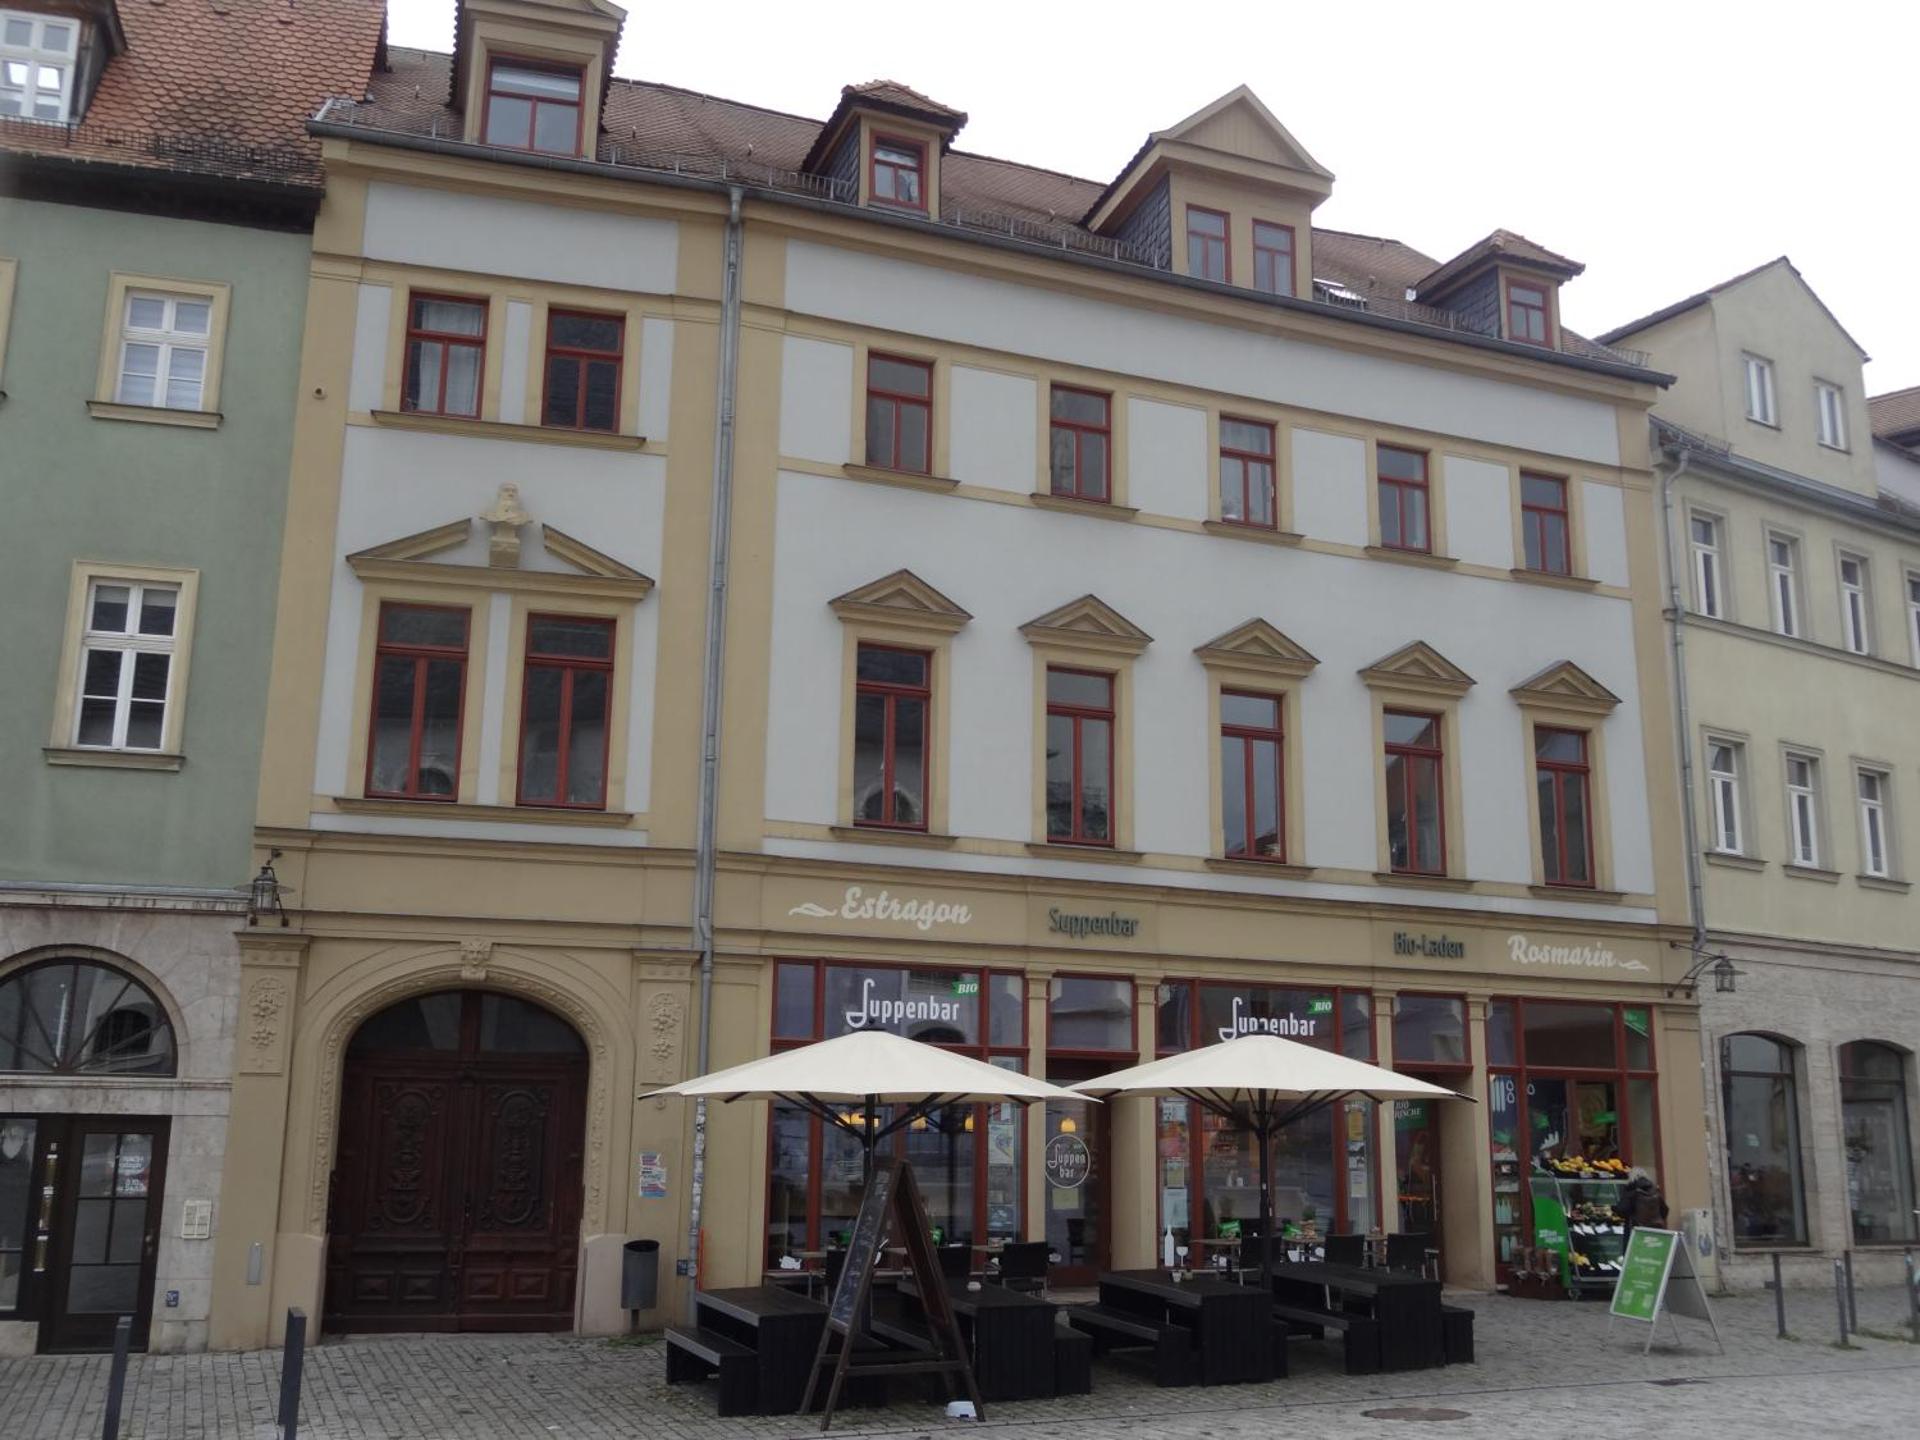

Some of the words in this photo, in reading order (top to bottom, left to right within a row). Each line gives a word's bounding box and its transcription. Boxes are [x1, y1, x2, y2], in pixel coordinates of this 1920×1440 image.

[841, 886, 972, 930] Estragon
[1048, 907, 1139, 938] Suppenbar
[1394, 931, 1464, 959] Bio-Laden
[1507, 934, 1616, 968] Rosmarin
[846, 978, 959, 1028] Suppenbar
[958, 983, 978, 994] BIO
[1059, 1165, 1075, 1178] bar
